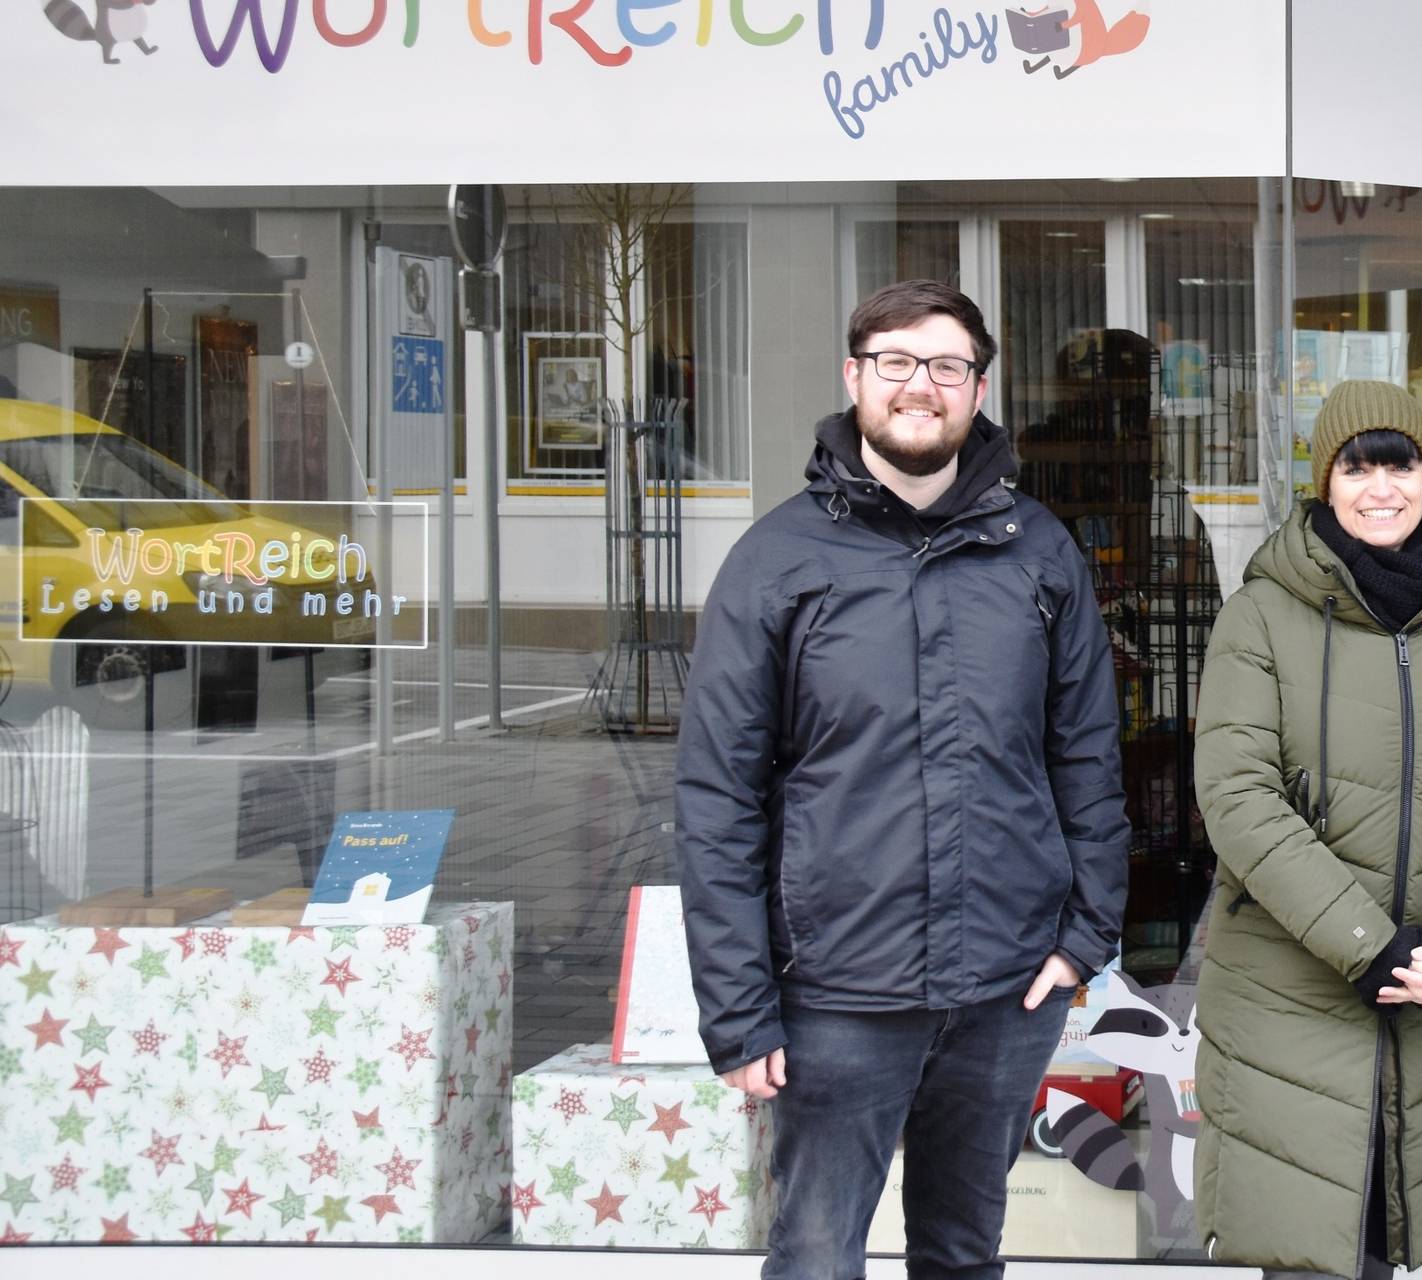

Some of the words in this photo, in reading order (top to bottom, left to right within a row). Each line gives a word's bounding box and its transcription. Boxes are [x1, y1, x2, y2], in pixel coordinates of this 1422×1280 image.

[823, 7, 998, 140] family
[86, 527, 368, 586] WortReich
[40, 583, 170, 615] Lesen
[198, 587, 274, 615] und
[302, 589, 408, 619] mehr
[343, 835, 377, 848] Pass
[379, 833, 409, 846] auf!
